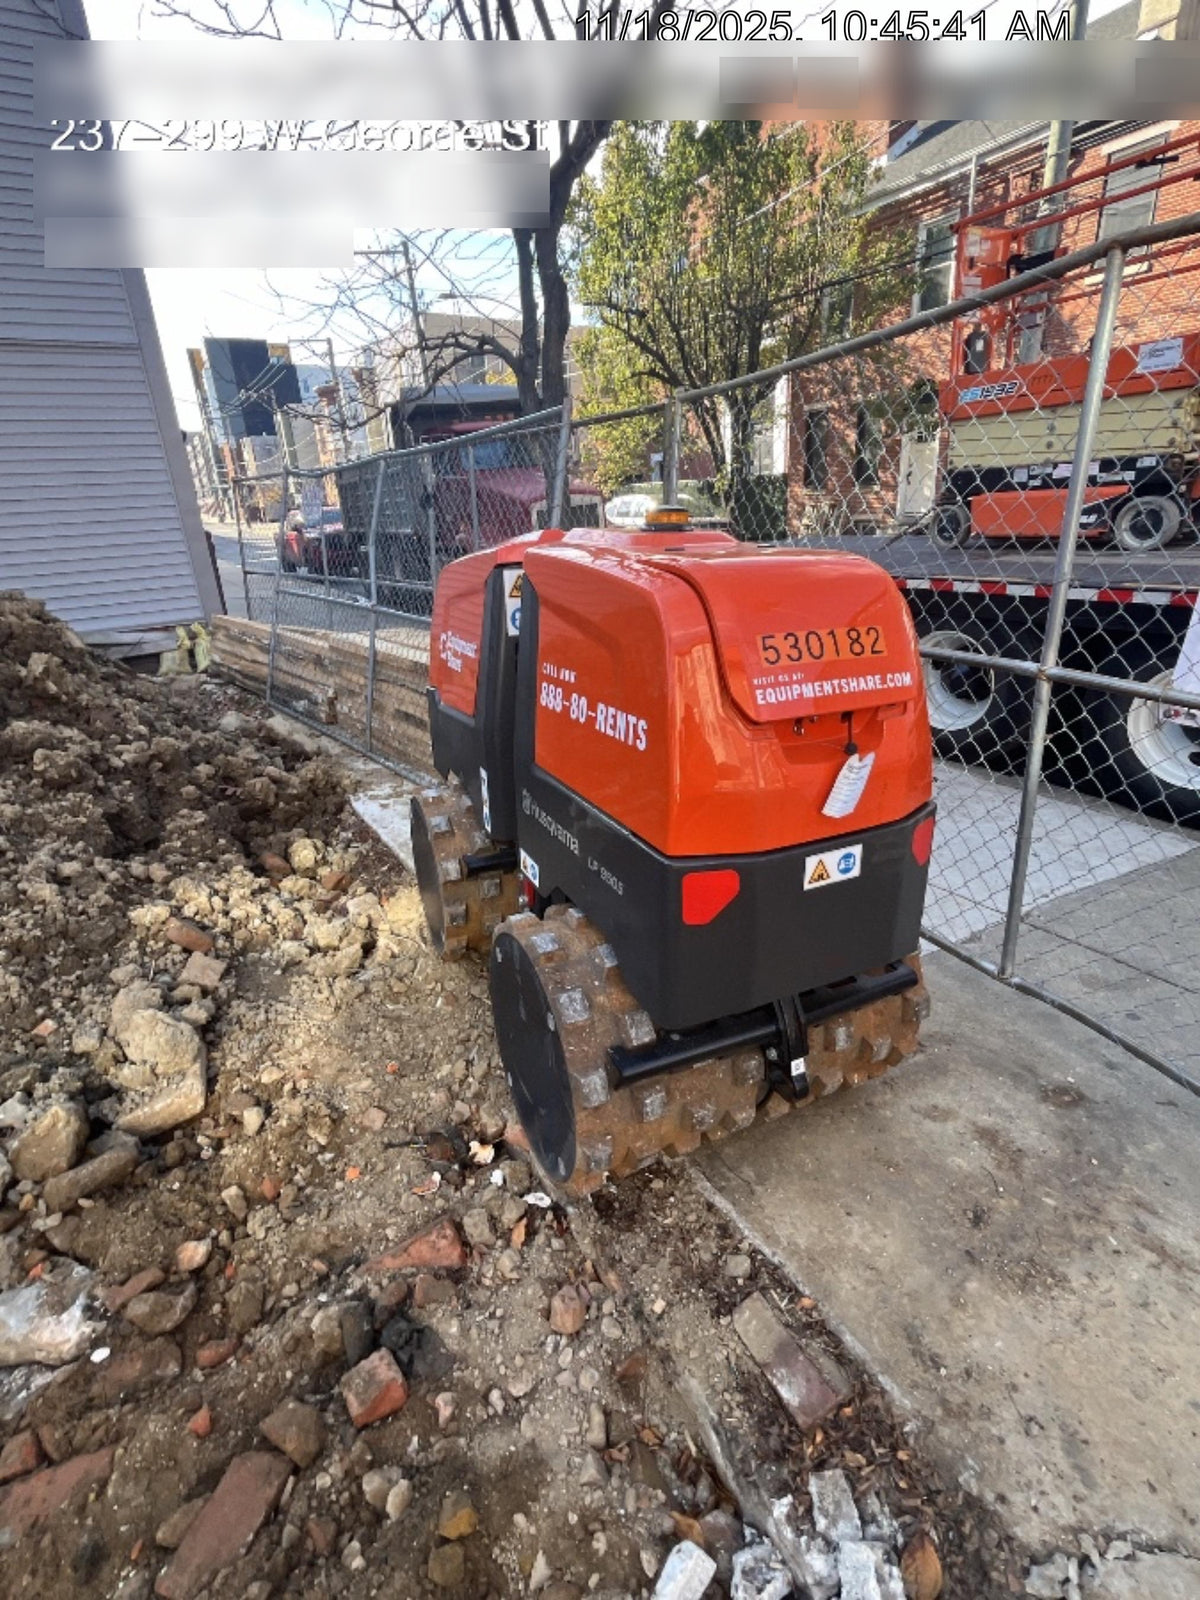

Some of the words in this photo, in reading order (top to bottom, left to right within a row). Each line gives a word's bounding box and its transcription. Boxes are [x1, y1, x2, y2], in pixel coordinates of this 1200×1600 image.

[761, 627, 884, 665] 530182
[542, 661, 558, 679] CALL
[559, 667, 577, 684] NOW
[752, 674, 775, 686] VISIT
[755, 671, 913, 706] EQUIPMENTSHARE.COM
[539, 680, 648, 752] 888-80-RENTS
